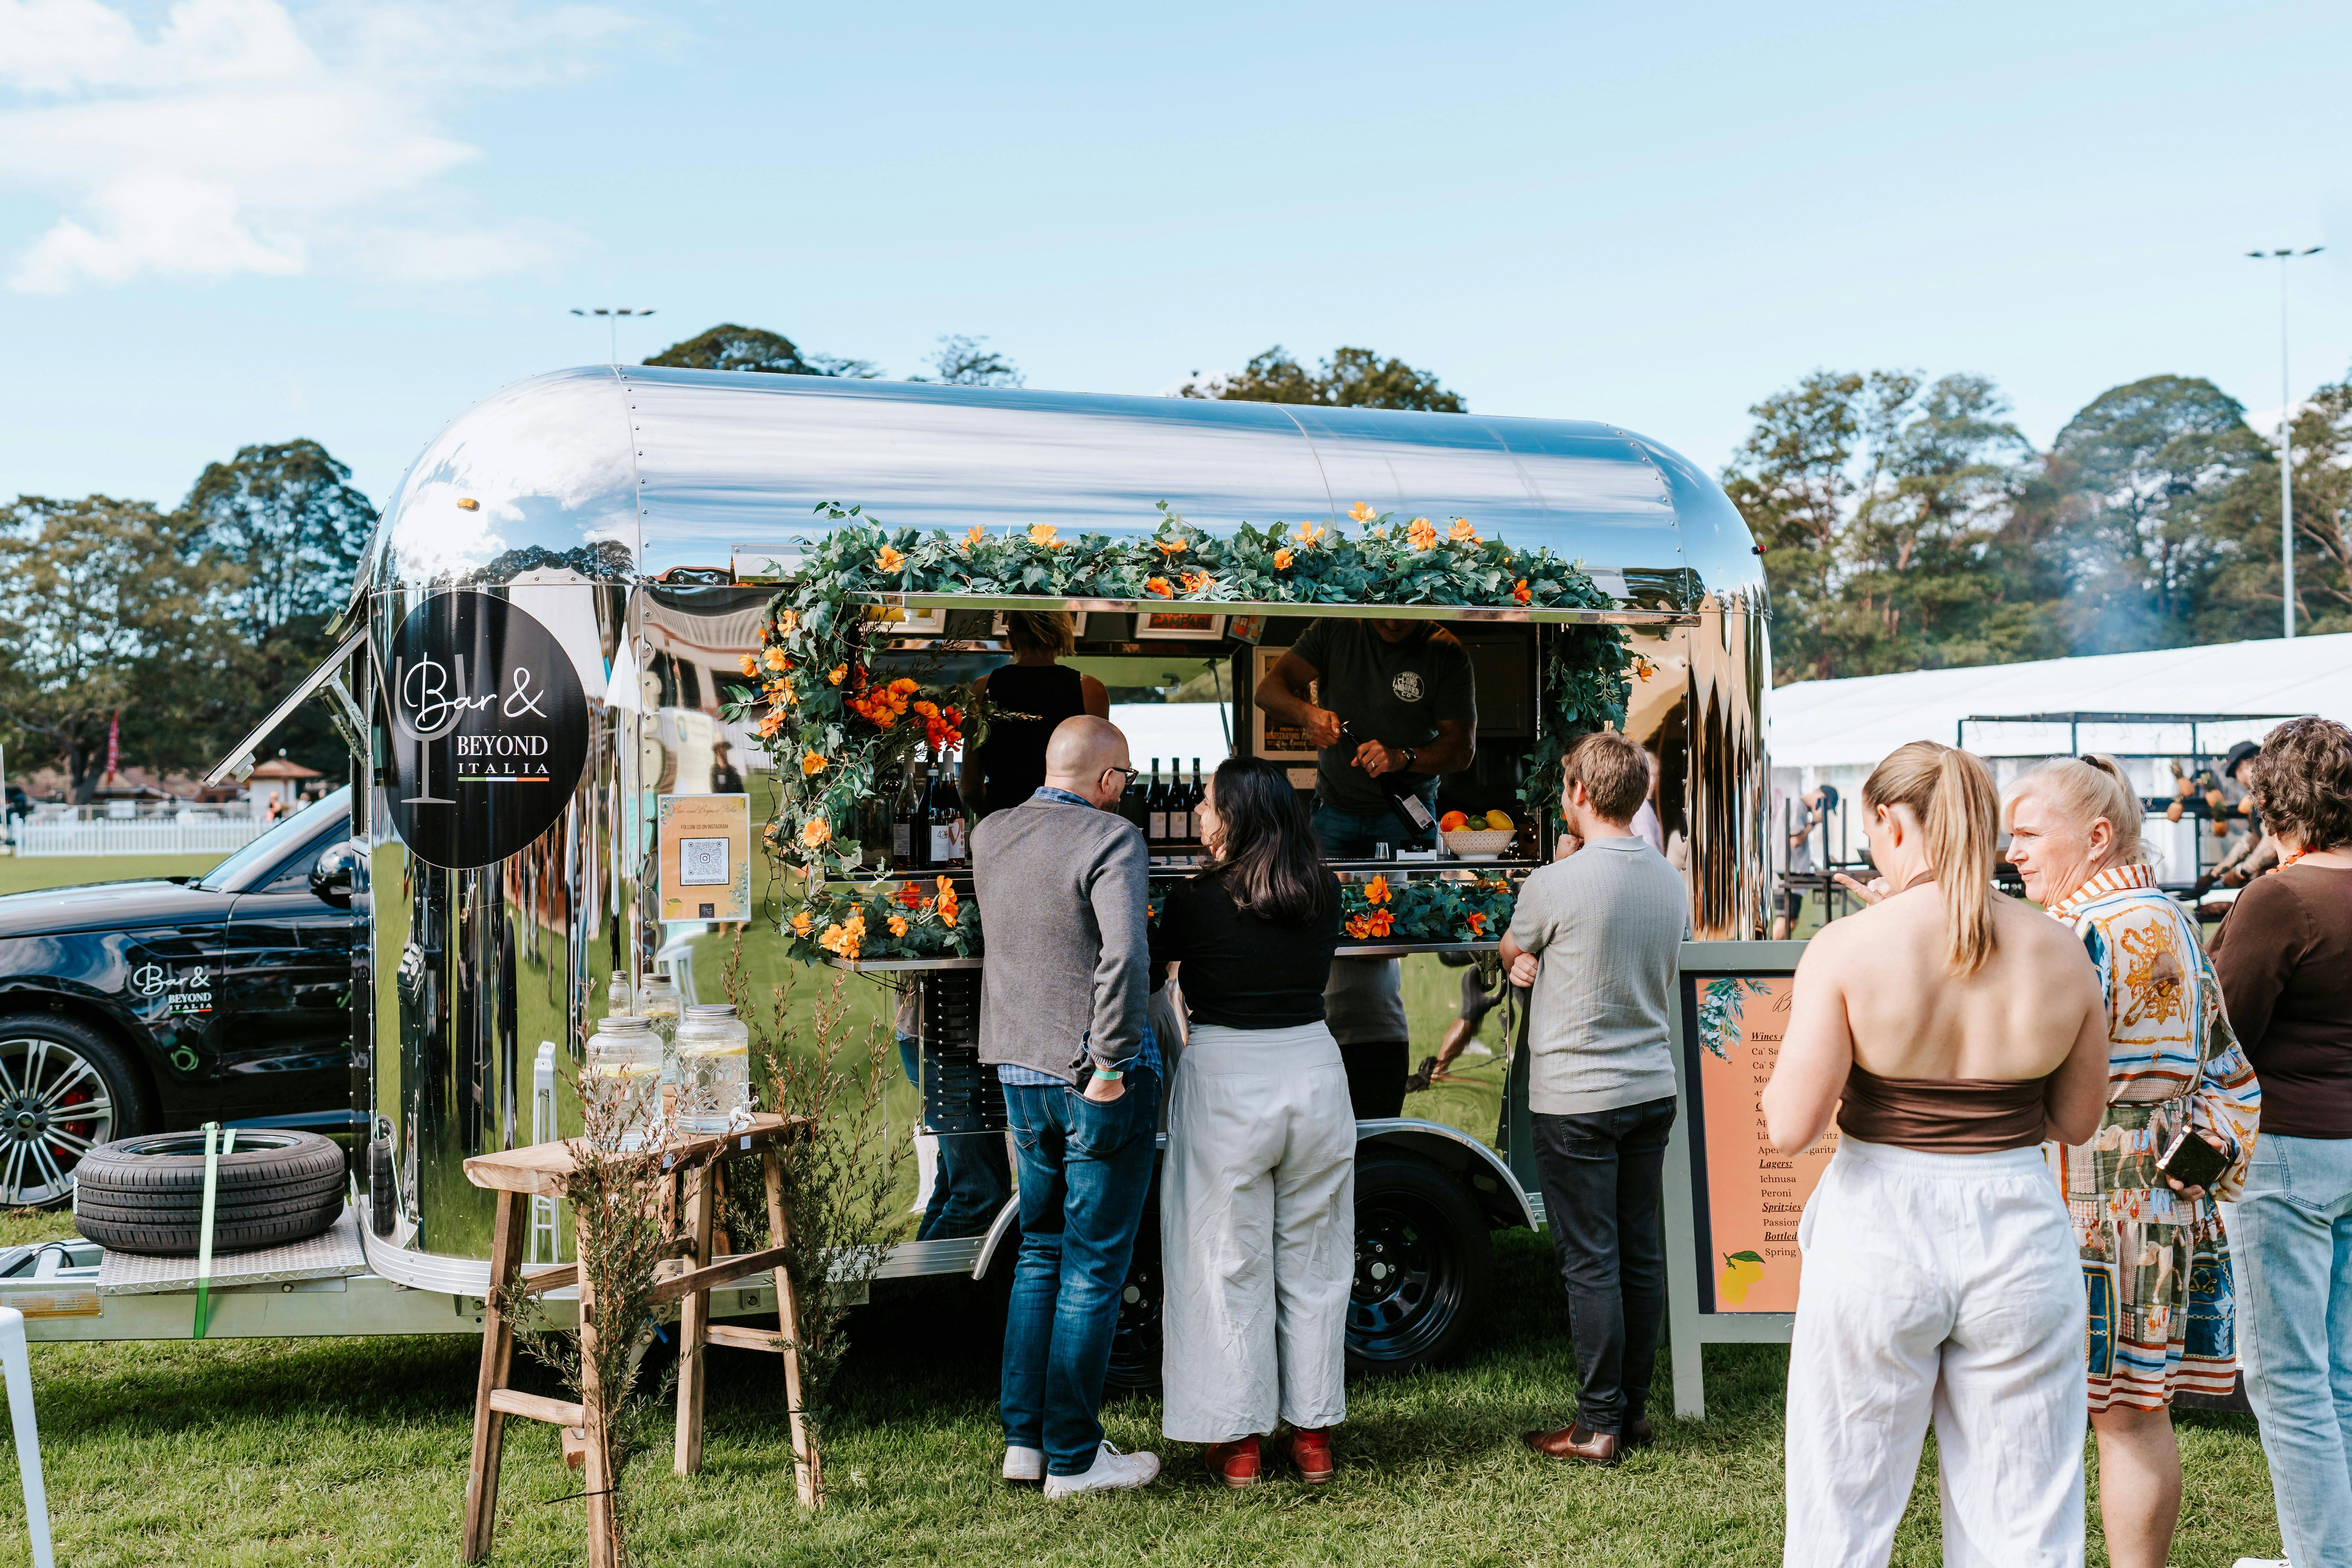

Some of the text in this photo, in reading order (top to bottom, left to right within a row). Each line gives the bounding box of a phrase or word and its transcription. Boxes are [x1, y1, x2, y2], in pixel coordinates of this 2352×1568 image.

[1151, 616, 1210, 628] CAMPARI
[1402, 677, 1417, 687] LONG
[404, 652, 547, 731] Bar &
[1400, 684, 1419, 695] BOARD
[457, 736, 548, 756] BEYOND
[458, 763, 549, 774] ITALIA
[672, 805, 685, 814] Bar
[698, 805, 723, 817] Beyond
[133, 962, 210, 995] Bar &
[168, 992, 212, 1004] BEYOND
[1751, 1032, 1778, 1040] Wines
[1760, 1159, 1792, 1169] Lagers:
[1762, 1202, 1801, 1213] Spritzies
[1763, 1218, 1800, 1226] Passion
[1765, 1232, 1797, 1240] Bottled
[1765, 1247, 1796, 1258] Spring
